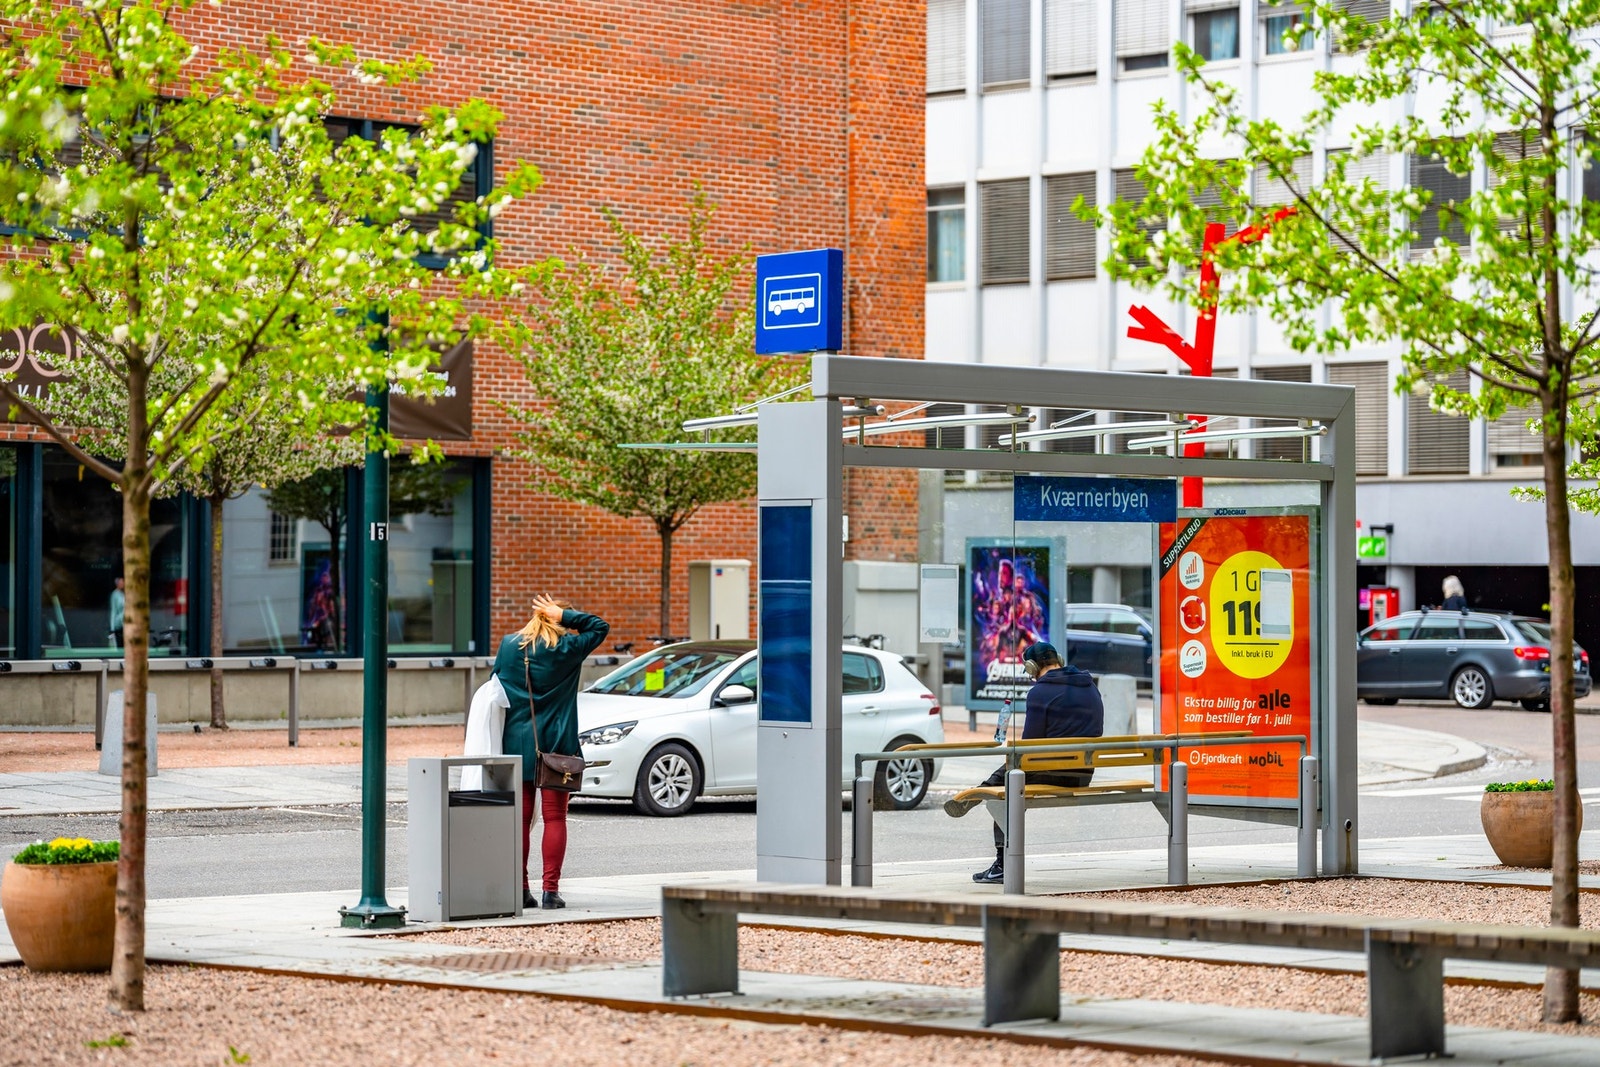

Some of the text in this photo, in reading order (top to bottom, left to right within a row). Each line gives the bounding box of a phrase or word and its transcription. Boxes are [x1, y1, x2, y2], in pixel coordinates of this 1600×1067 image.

[1040, 485, 1149, 513] Kværnerbyen
[1213, 508, 1247, 516] JCDecaux
[377, 527, 384, 541] 5
[1163, 518, 1201, 568] SUPERTILBUD
[1231, 570, 1262, 592] 1 G
[1264, 650, 1274, 658] EU
[1184, 688, 1291, 711] Ekstra billig for alle
[1183, 712, 1293, 727] som bestiller før 1. juli!
[1200, 752, 1243, 766] Fjordkraft
